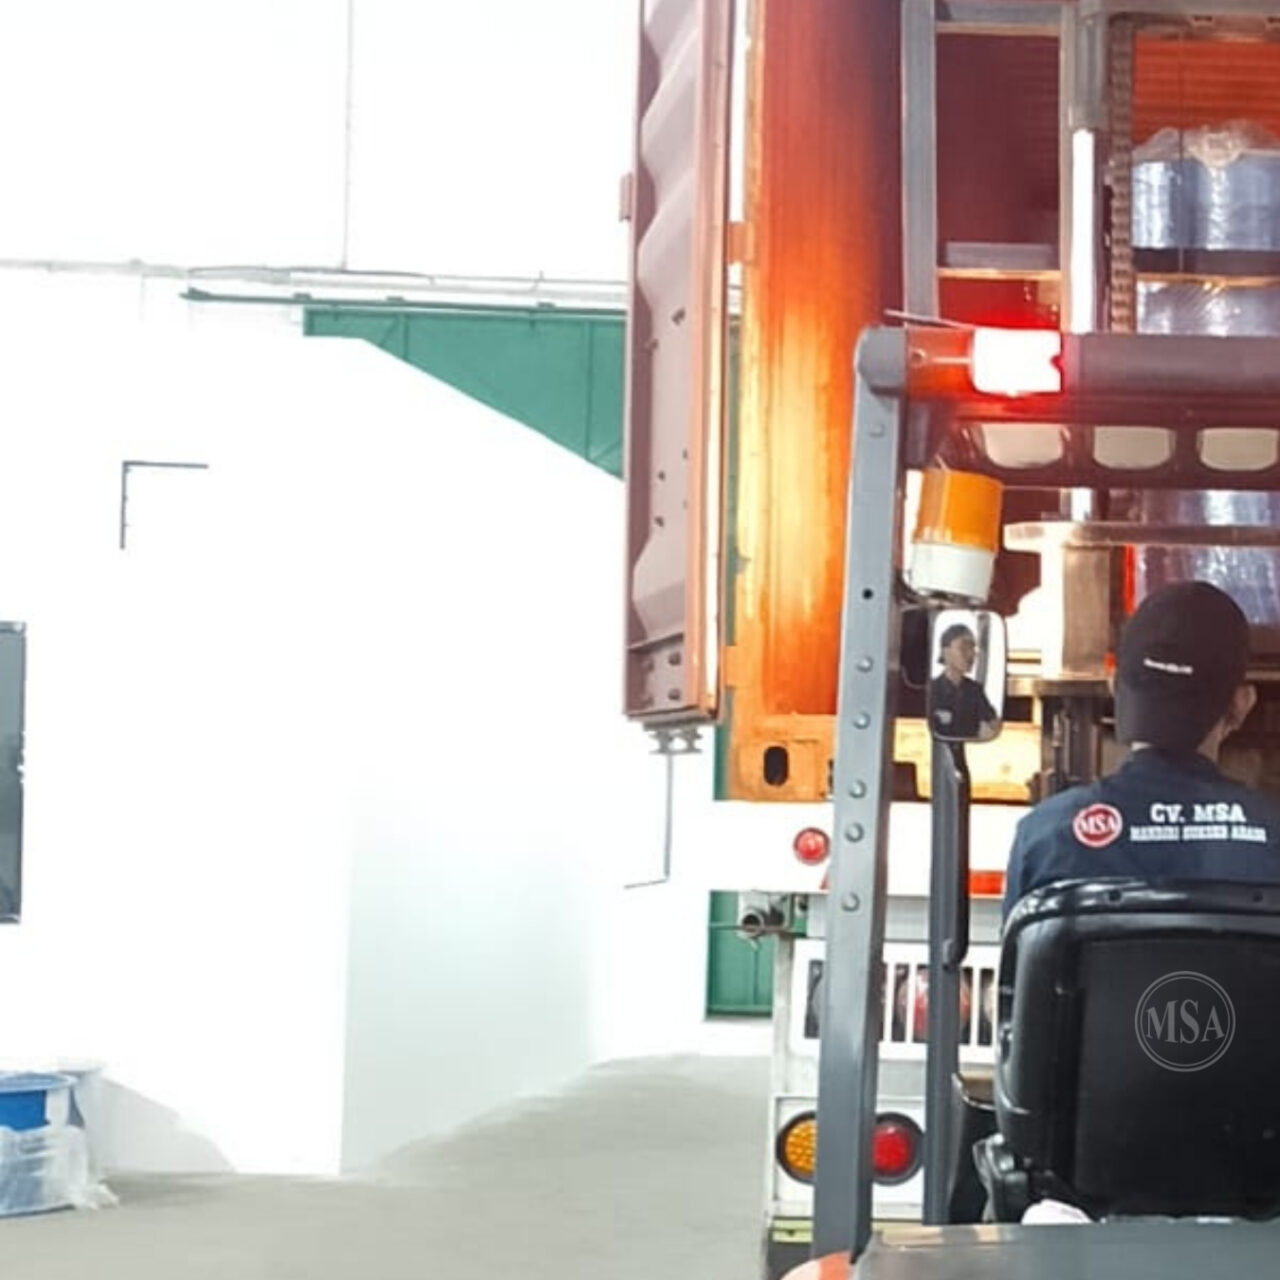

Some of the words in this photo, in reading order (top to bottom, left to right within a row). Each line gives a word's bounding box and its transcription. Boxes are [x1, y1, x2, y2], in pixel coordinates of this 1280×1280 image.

[1078, 812, 1117, 835] MSA
[1150, 803, 1185, 823] CV.
[1193, 803, 1246, 823] MSA
